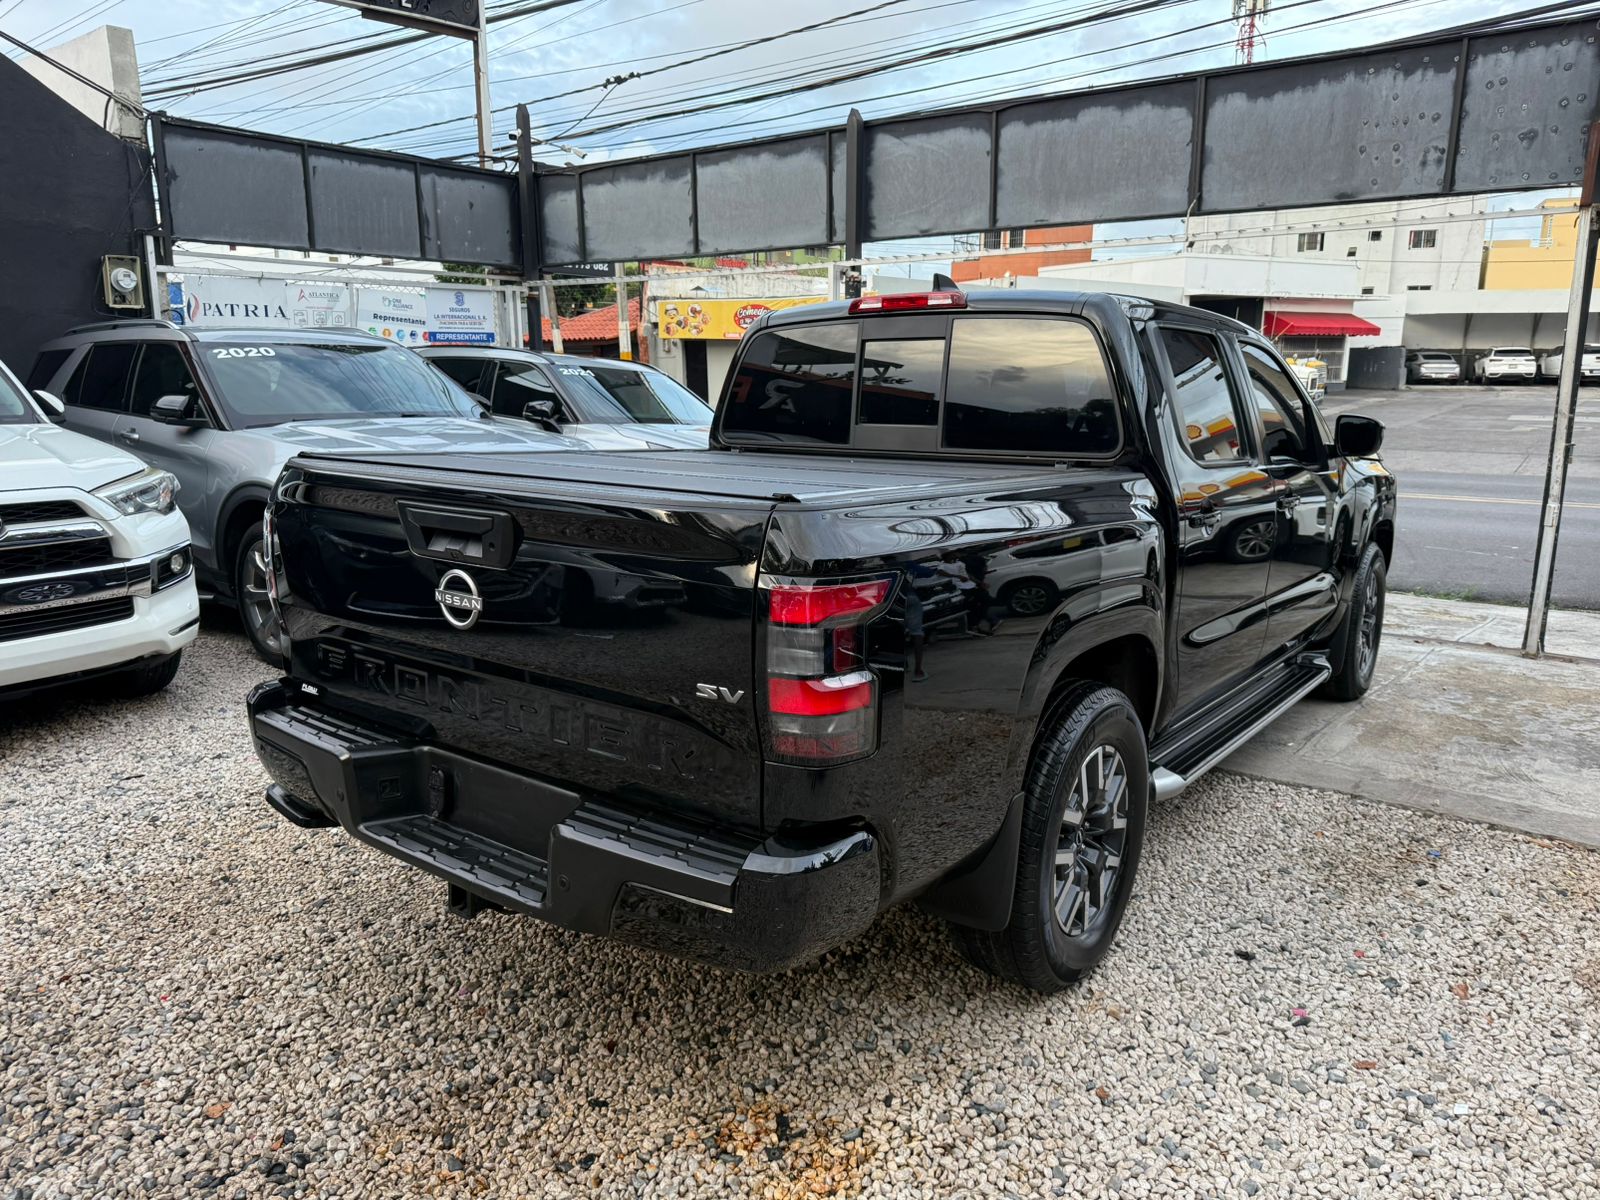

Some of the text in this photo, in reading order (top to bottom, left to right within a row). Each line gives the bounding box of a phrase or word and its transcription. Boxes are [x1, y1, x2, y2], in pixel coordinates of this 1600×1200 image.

[202, 302, 290, 321] PATRIA
[372, 313, 426, 326] Representante
[435, 333, 488, 341] REPRESENTANTE
[212, 346, 276, 359] 2020
[435, 590, 481, 610] NISSAN
[695, 683, 745, 704] SV
[317, 643, 697, 781] FRONTIER
